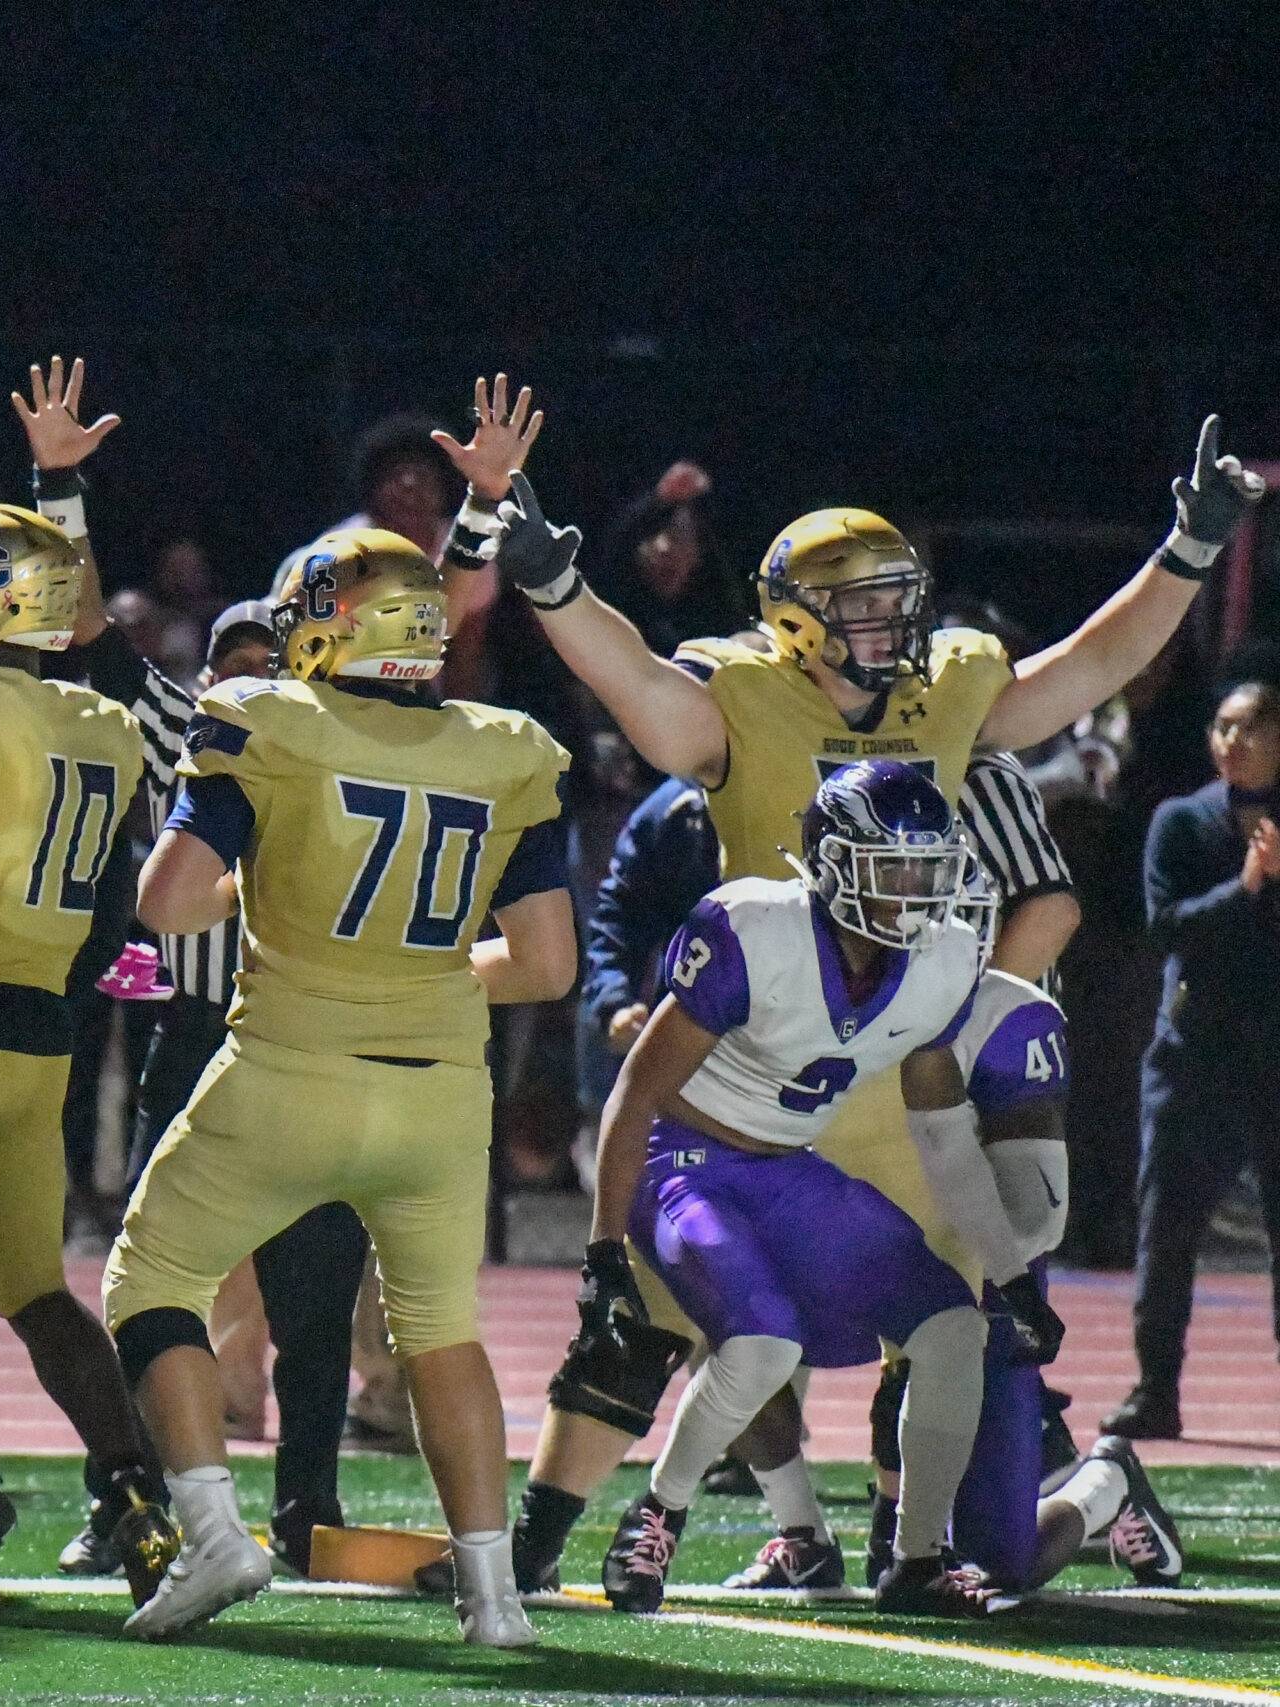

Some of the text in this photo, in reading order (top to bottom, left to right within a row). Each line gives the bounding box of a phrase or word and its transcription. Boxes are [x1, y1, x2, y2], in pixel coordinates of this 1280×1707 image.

[26, 752, 120, 915] 10
[331, 774, 495, 952] 70
[672, 937, 711, 988] 3
[1025, 1031, 1065, 1083] 41
